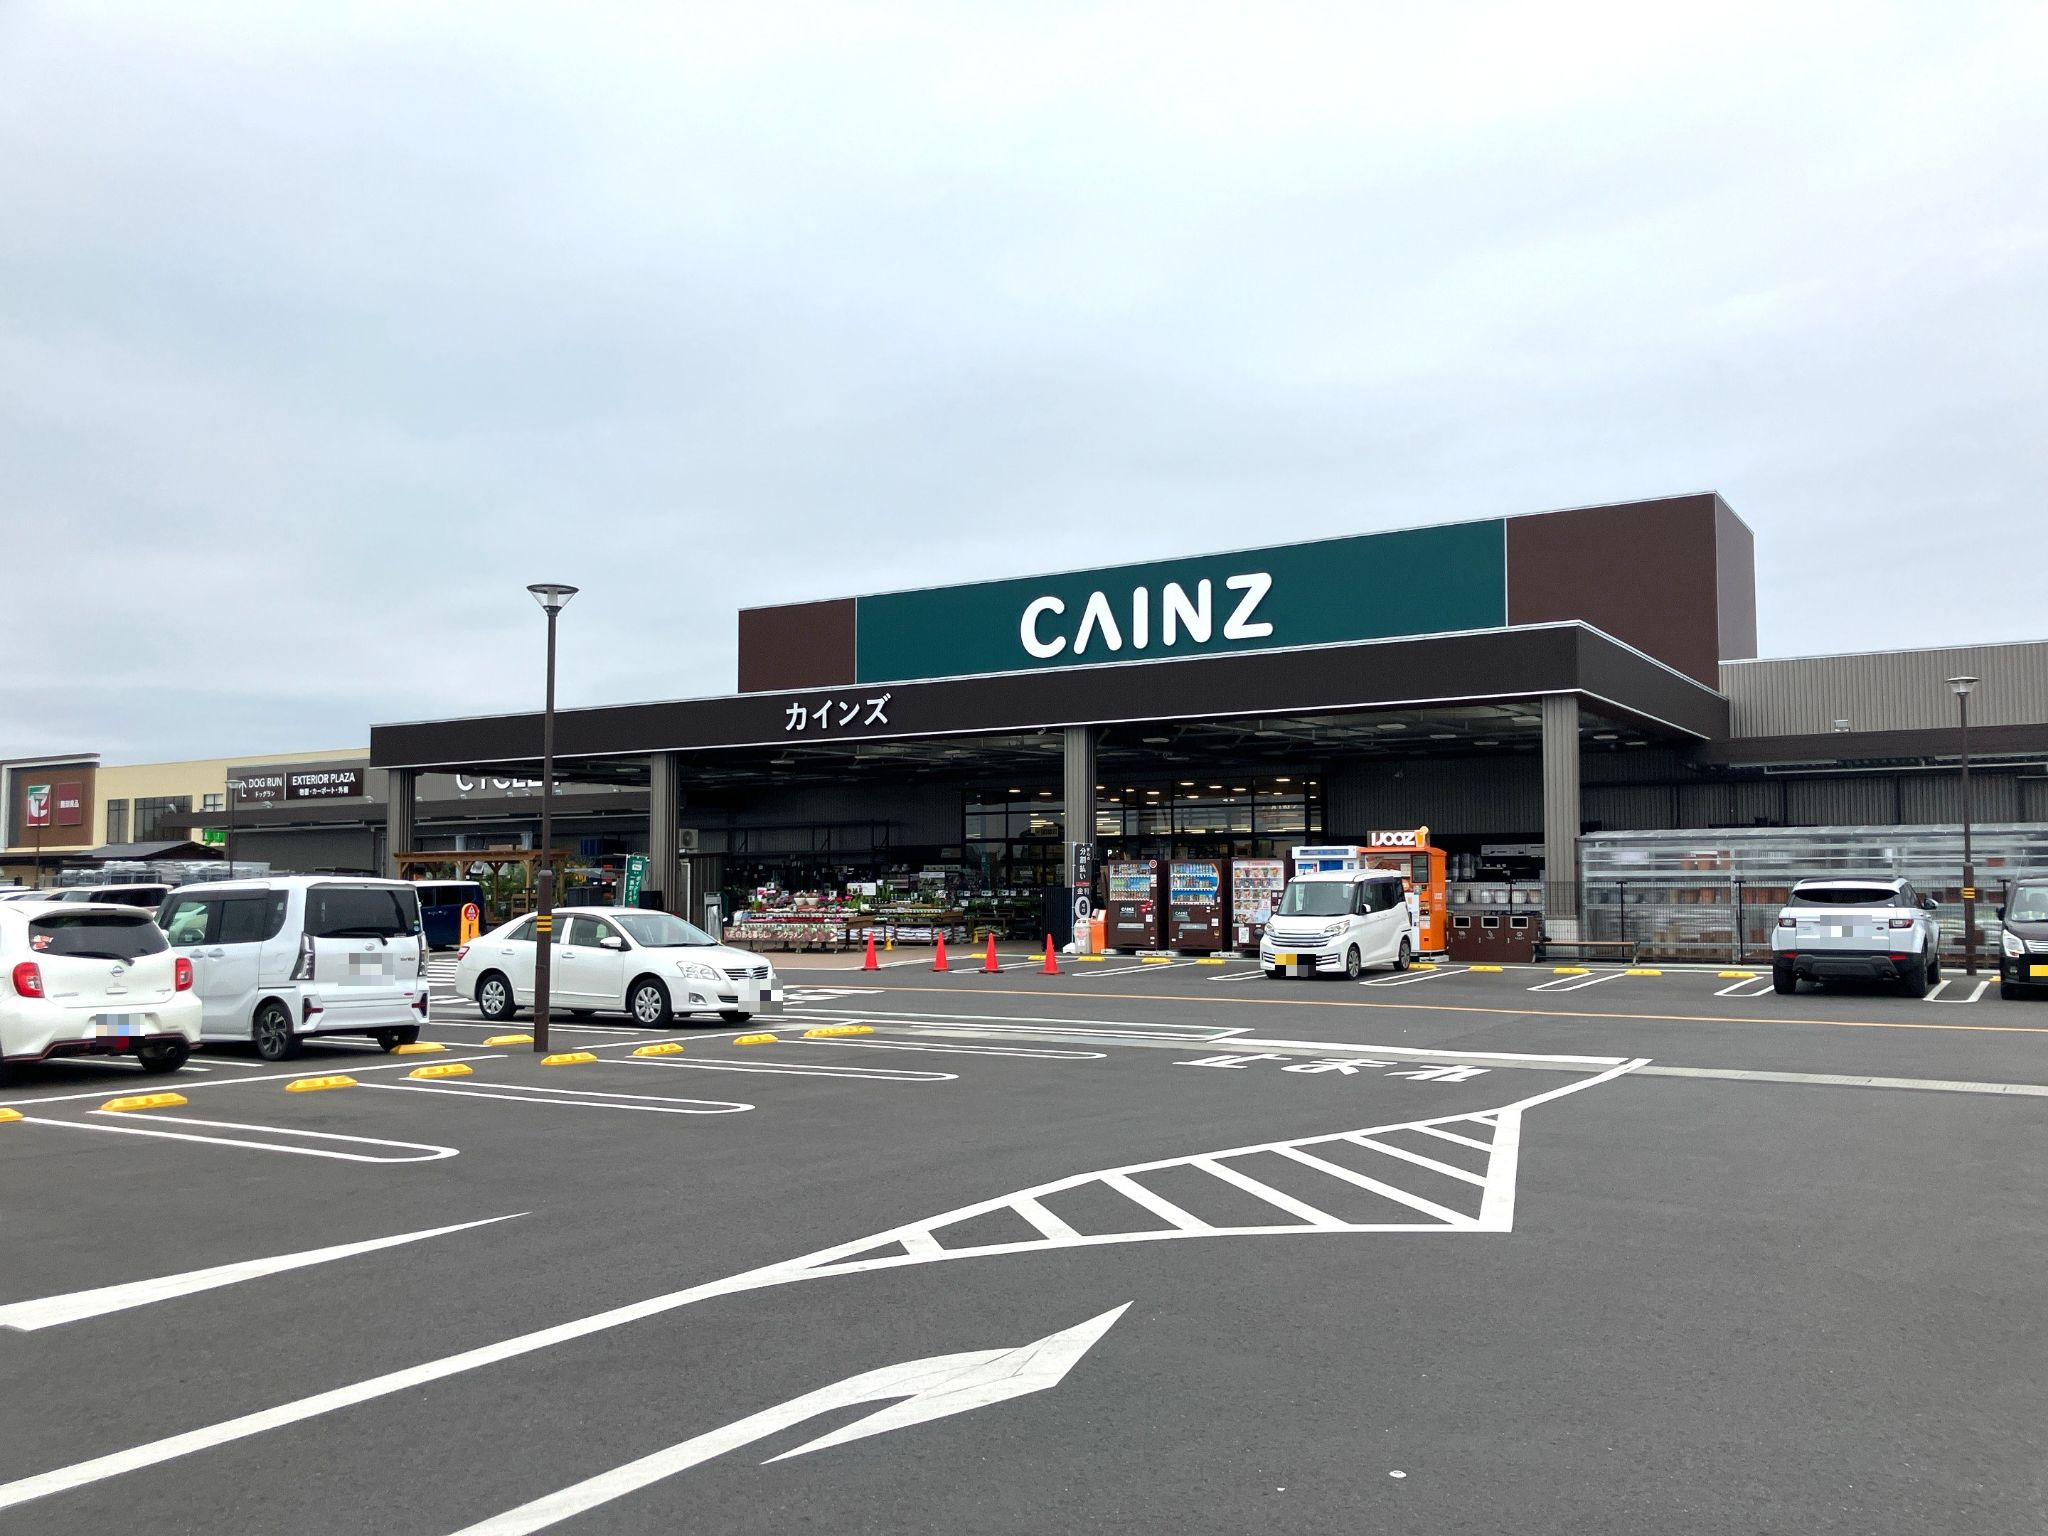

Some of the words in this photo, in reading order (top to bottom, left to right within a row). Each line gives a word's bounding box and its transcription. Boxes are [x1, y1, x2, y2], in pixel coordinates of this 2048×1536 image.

[1019, 571, 1275, 659] CAINZ
[784, 692, 892, 732] カインズ
[248, 778, 266, 788] DOG
[266, 777, 283, 787] RUN
[292, 773, 329, 786] EXTERIOR
[330, 772, 355, 784] PLAZA
[1079, 847, 1087, 880] 分割払い
[1172, 1053, 1493, 1083] 止まれ
